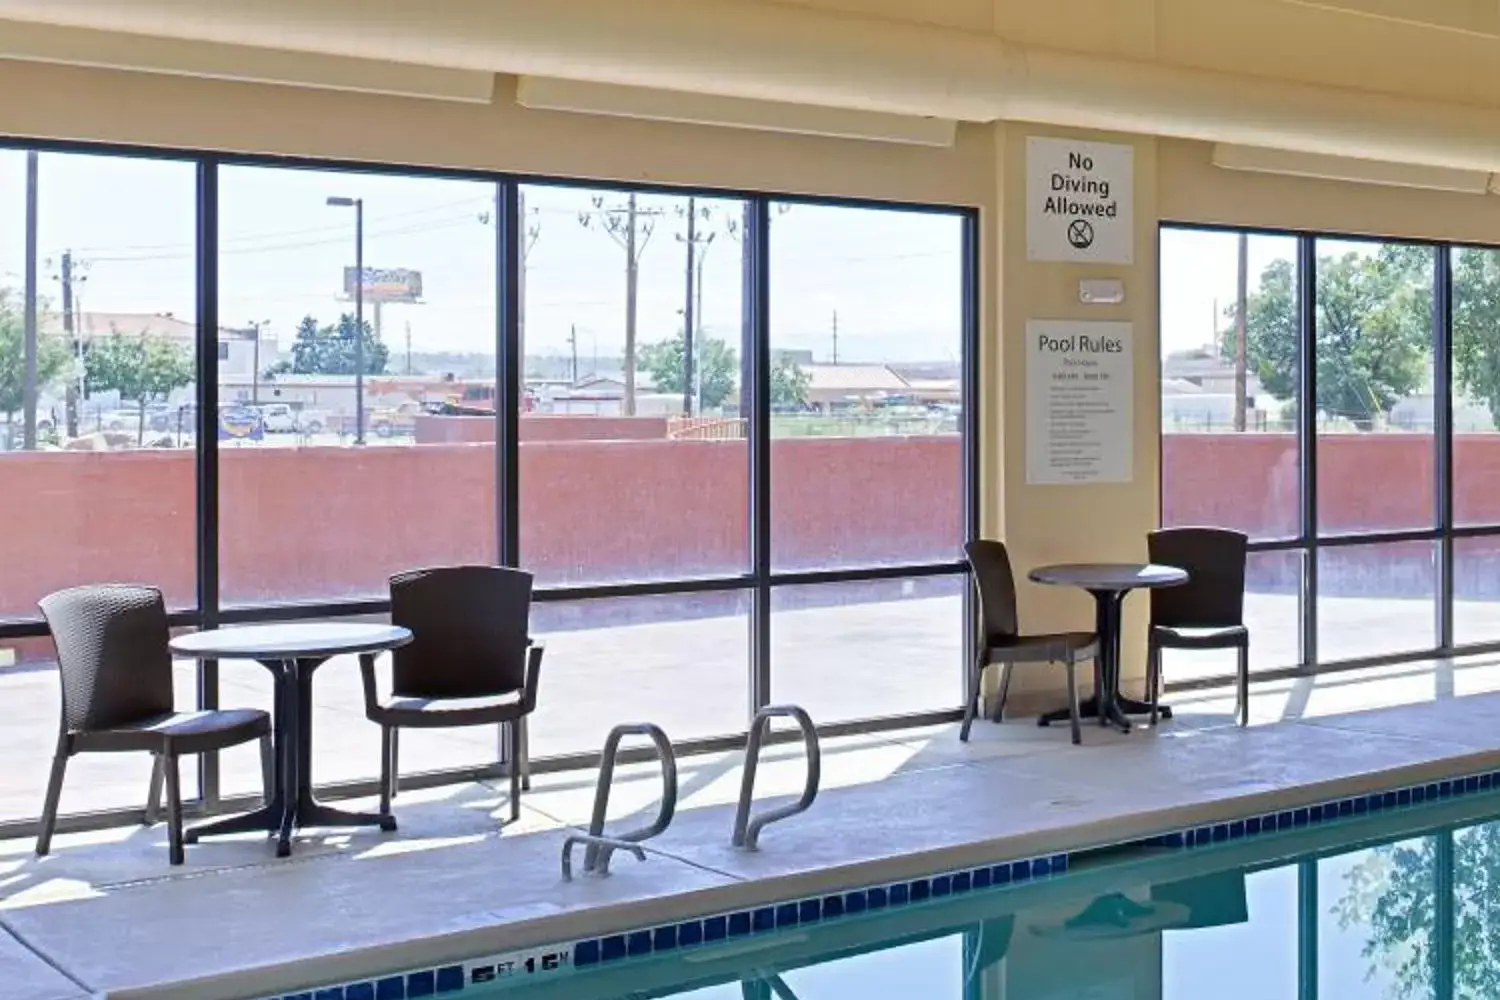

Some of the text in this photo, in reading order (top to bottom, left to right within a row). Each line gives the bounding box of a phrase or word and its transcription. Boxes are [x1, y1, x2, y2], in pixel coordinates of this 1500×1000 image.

[1068, 152, 1093, 171] No
[1051, 173, 1109, 199] Diving
[1043, 196, 1117, 217] Allowed
[1039, 334, 1123, 353] Pool Rules
[471, 965, 496, 984] 5
[497, 961, 515, 976] FT
